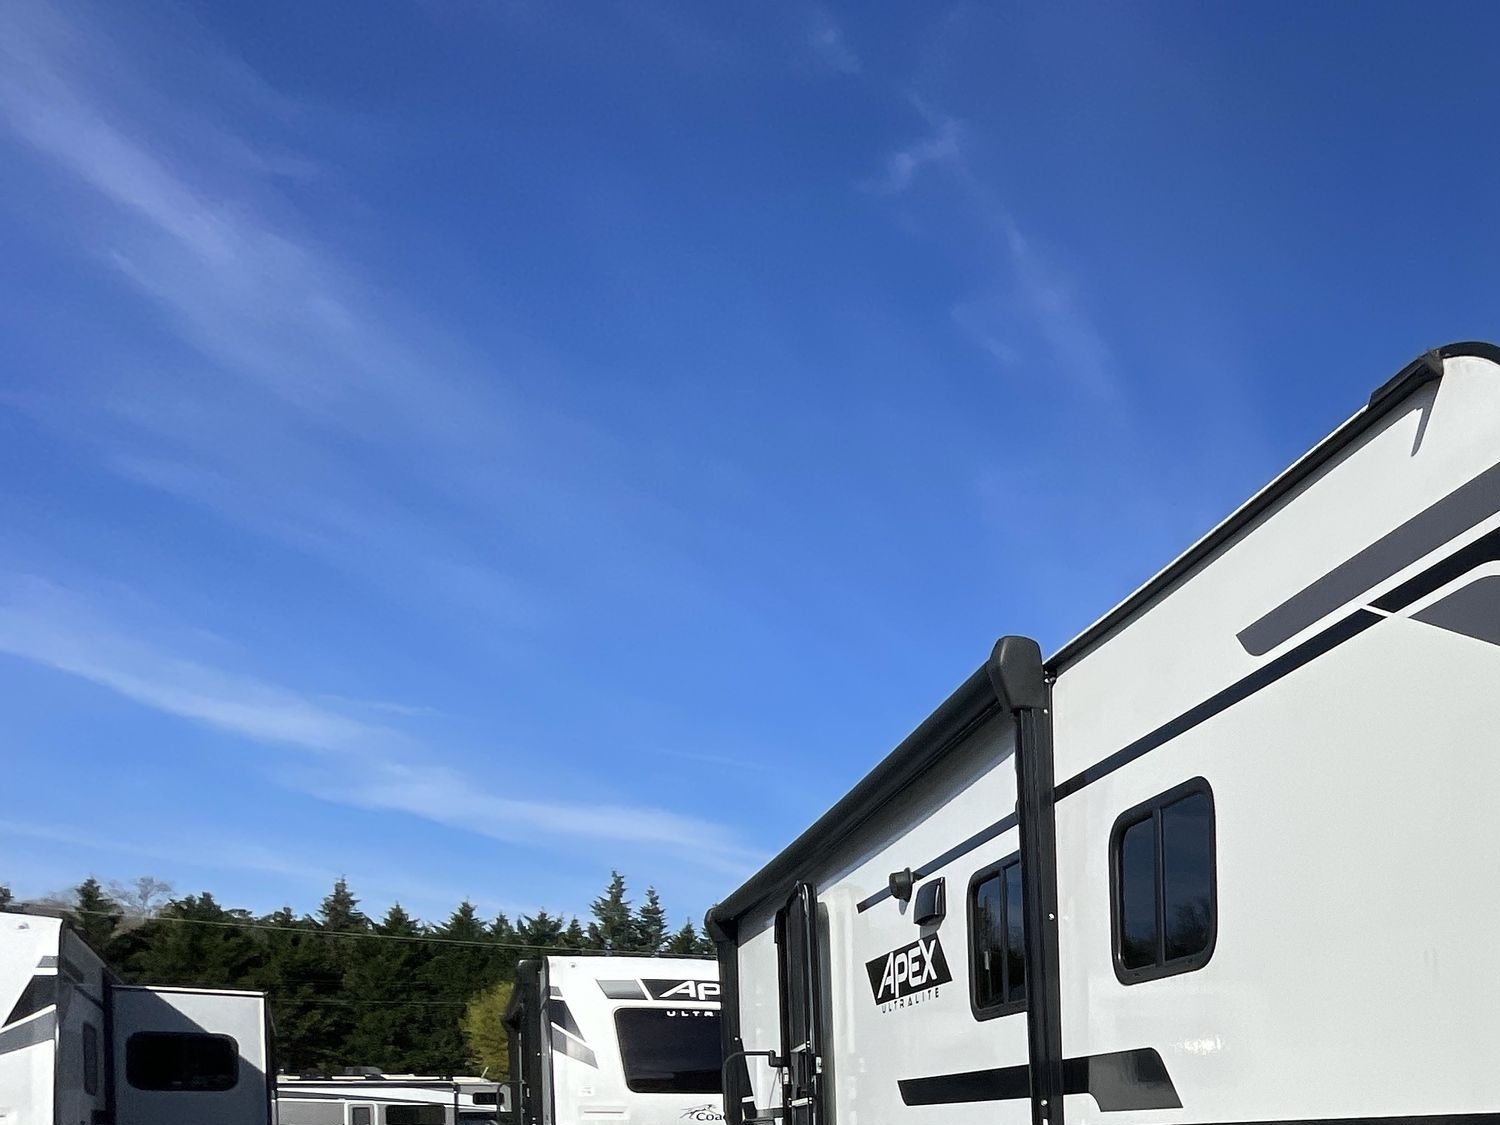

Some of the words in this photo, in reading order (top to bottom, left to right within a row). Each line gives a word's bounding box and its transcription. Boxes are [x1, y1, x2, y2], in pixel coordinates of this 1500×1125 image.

[877, 938, 938, 1000] APEX
[659, 980, 721, 1001] AP
[881, 987, 940, 1014] ULTRALITE
